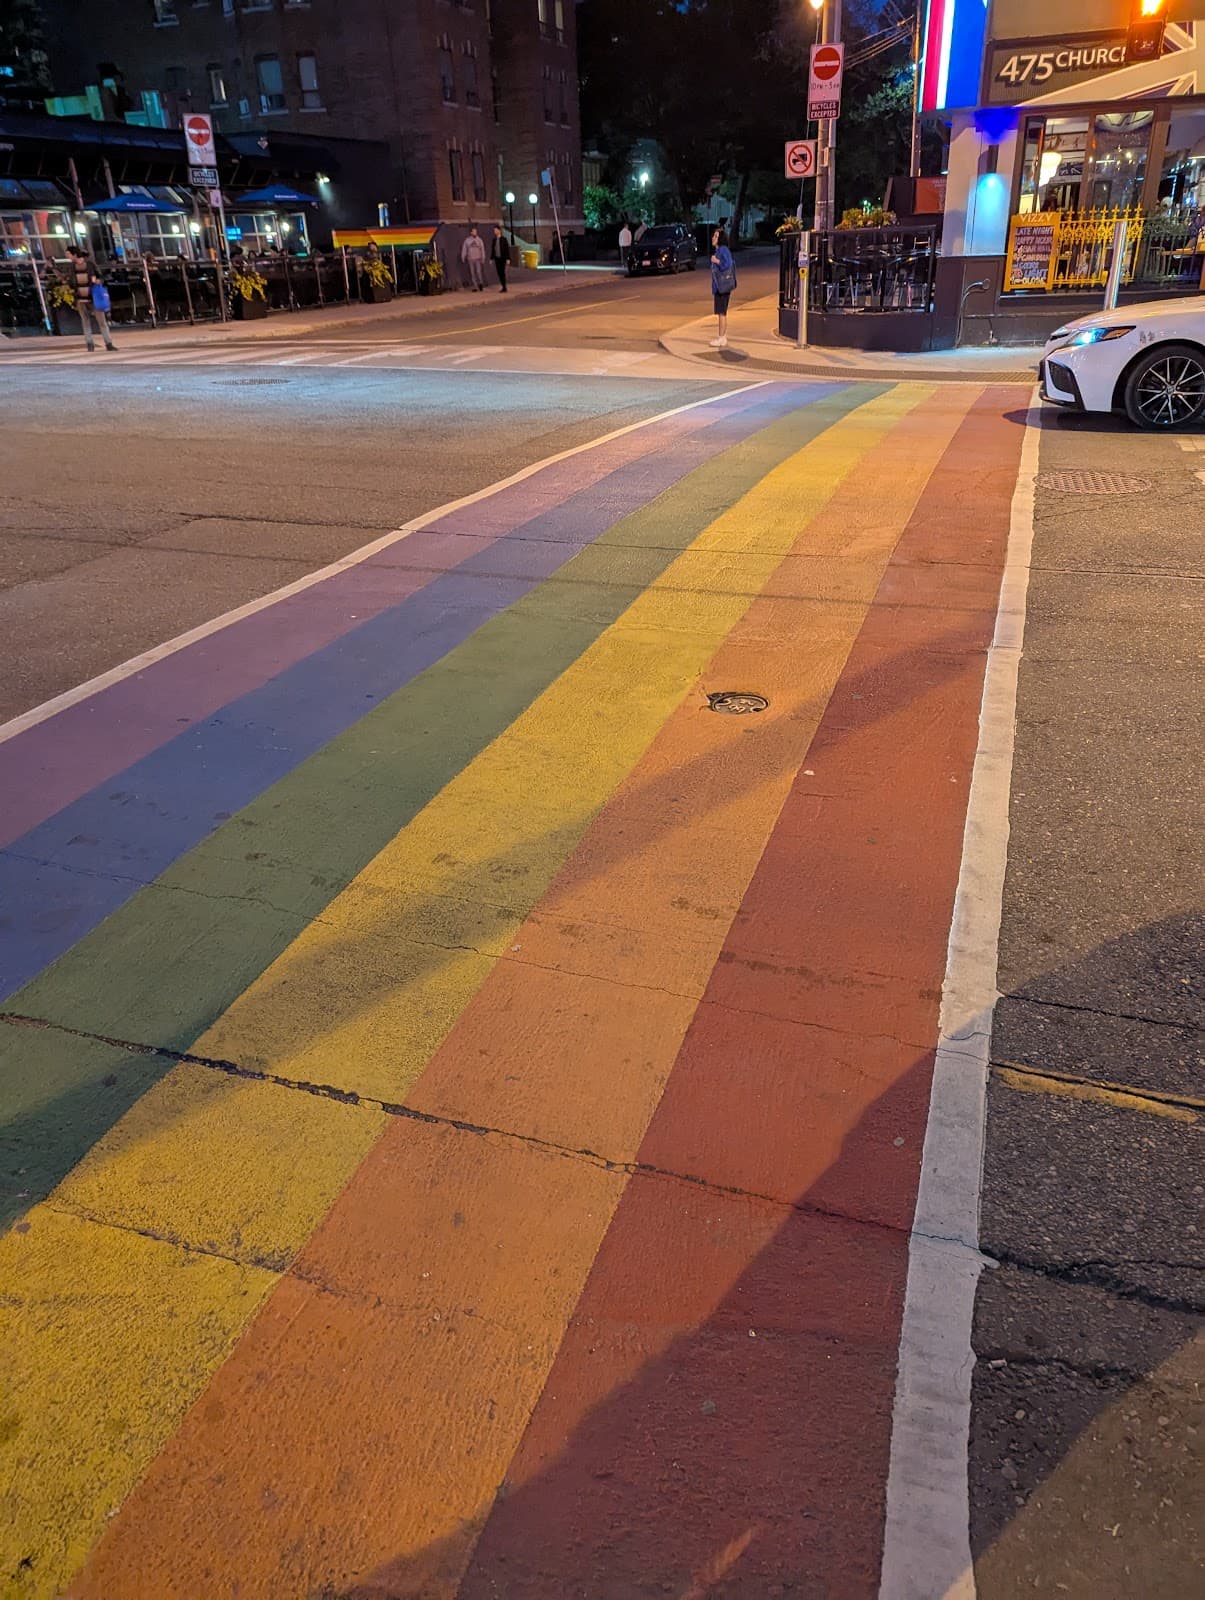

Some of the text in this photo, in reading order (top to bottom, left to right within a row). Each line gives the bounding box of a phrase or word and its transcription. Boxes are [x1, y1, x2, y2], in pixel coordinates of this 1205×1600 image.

[1000, 54, 1053, 82] 475
[811, 110, 837, 118] EXCEPTED
[1020, 214, 1052, 222] VIZZY
[1016, 226, 1053, 236] LATE NIGHT
